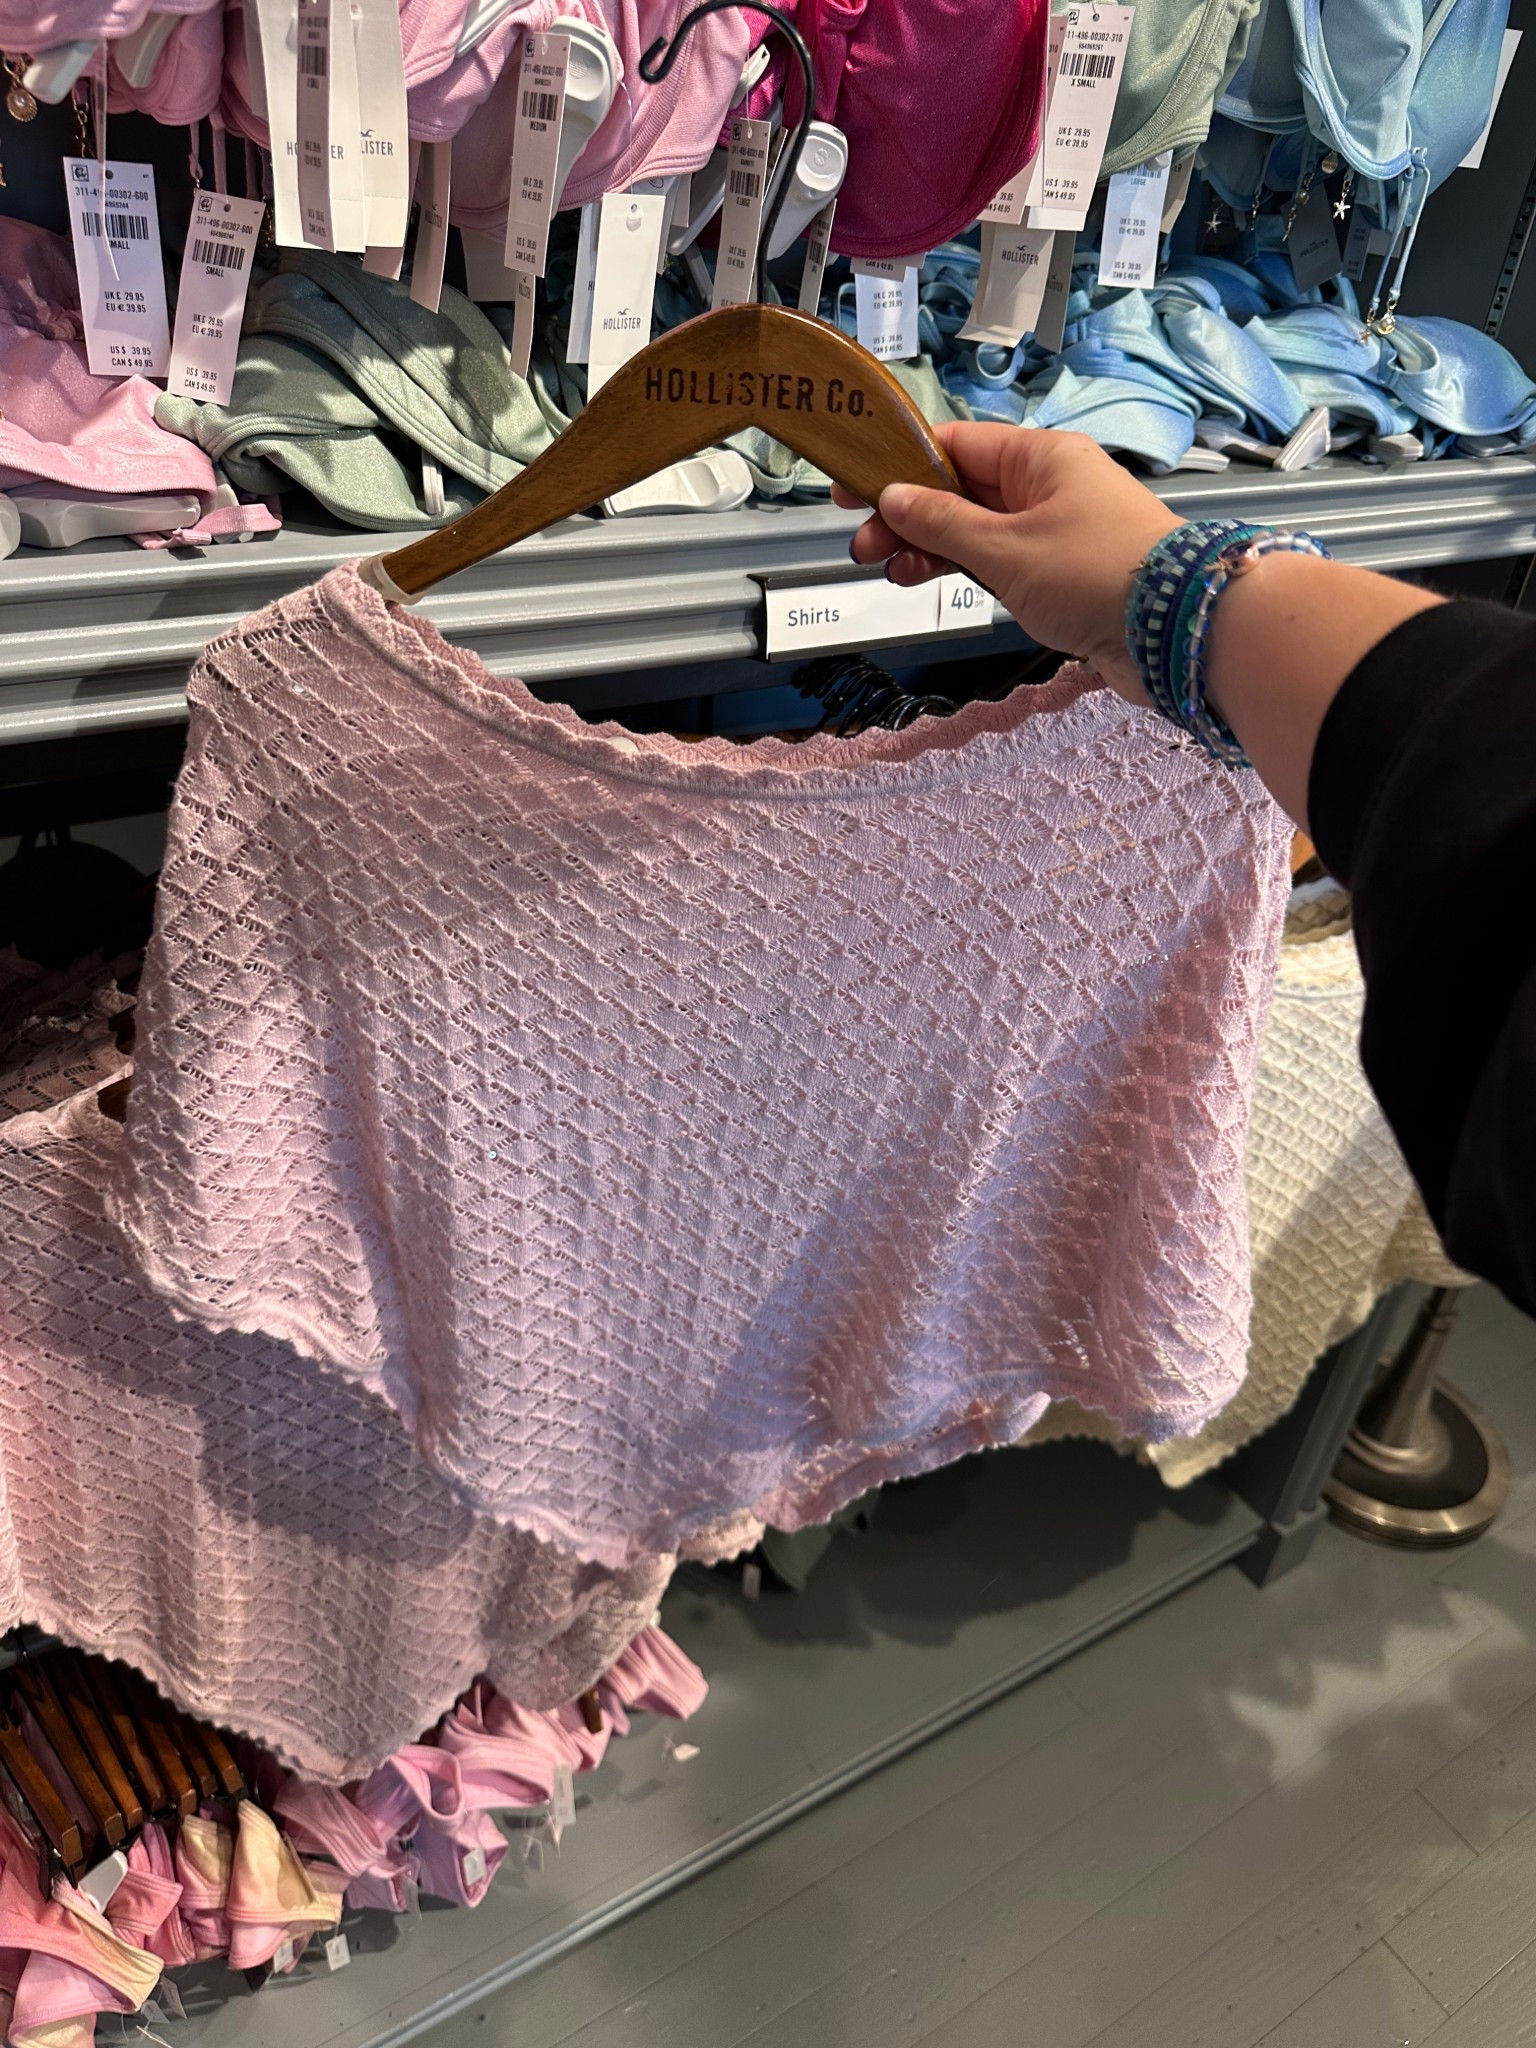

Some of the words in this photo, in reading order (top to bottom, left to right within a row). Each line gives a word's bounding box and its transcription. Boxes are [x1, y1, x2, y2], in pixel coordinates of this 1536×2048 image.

[1067, 31, 1123, 42] 11-496-00302-310
[1077, 79, 1096, 88] SMALL
[530, 121, 547, 132] MEDIUM
[1059, 127, 1067, 135] UK
[1074, 128, 1091, 138] 29.95
[1056, 138, 1064, 146] EU
[361, 140, 393, 156] LISTER
[1045, 179, 1053, 187] US
[1062, 180, 1078, 189] 39.95
[1131, 178, 1147, 186] LARGE
[75, 187, 149, 200] 311-4-00302-600
[999, 192, 1014, 201] 39.95
[1044, 190, 1054, 198] AN
[1060, 191, 1076, 200] 49.95
[997, 204, 1011, 213] 49.95
[1002, 250, 1039, 266] HOLLISTER
[206, 266, 224, 277] SMALL
[104, 291, 115, 300] UK
[124, 291, 145, 301] 29.95
[106, 302, 116, 311] EU
[118, 303, 125, 311] €
[193, 313, 201, 322] UK
[208, 316, 224, 327] 29.95
[603, 317, 641, 330] HOLLISTER
[192, 325, 199, 334] EU
[110, 346, 120, 354] US
[132, 346, 151, 355] 39.95
[112, 358, 126, 367] CAN
[134, 359, 153, 368] 49.95
[186, 367, 193, 375] US
[202, 370, 217, 381] 39.95
[185, 379, 195, 388] CAN
[201, 383, 216, 393] 49.95
[646, 367, 814, 413] HOLLISTER
[788, 608, 840, 627] Shirts
